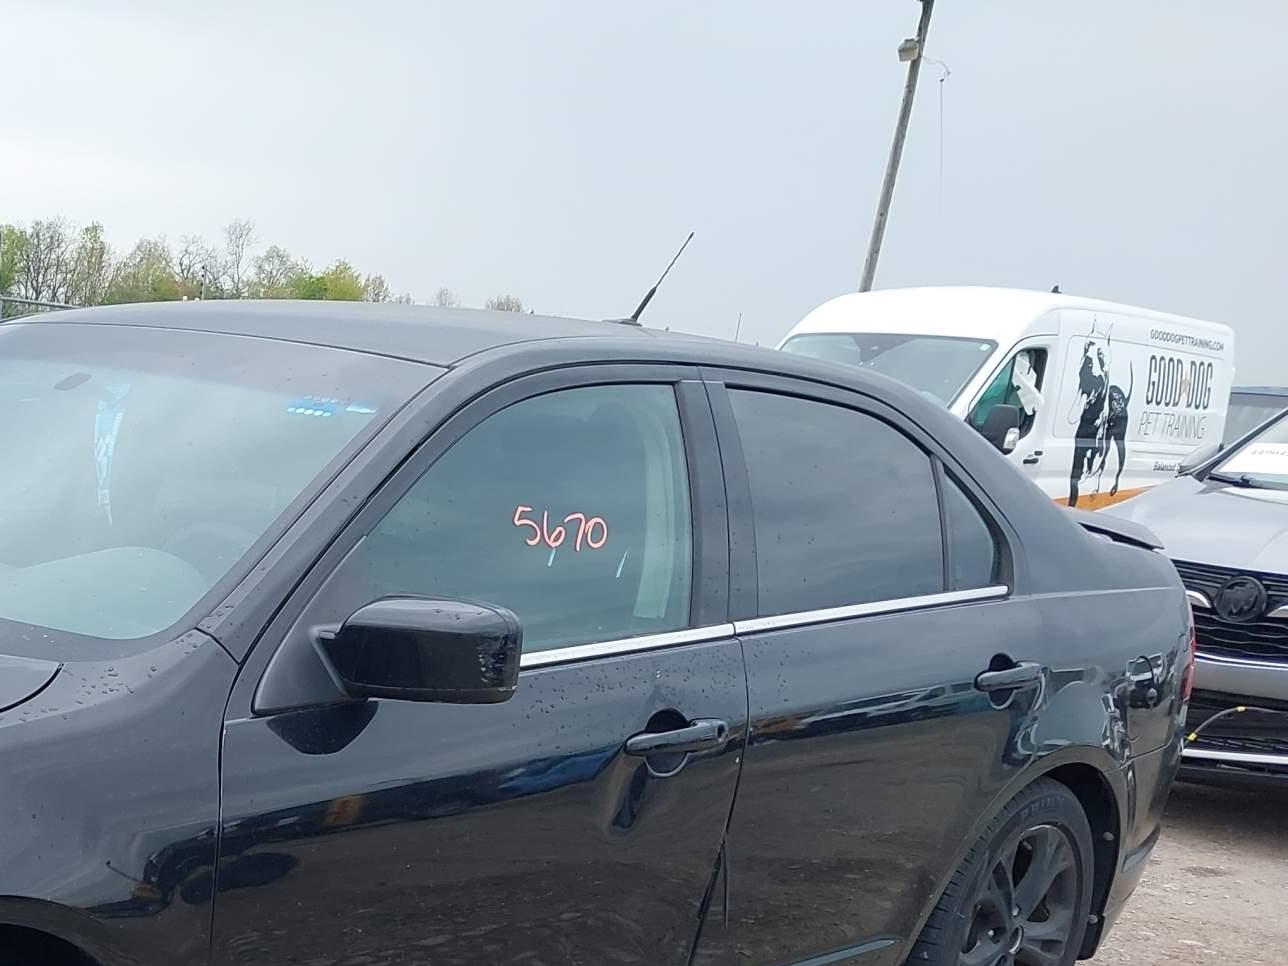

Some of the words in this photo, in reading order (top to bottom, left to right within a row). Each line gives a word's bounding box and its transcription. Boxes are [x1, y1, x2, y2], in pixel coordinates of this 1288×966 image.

[1150, 328, 1225, 352] GOODDOGPETTRAINING.COM
[1145, 354, 1184, 408] GOOD
[1185, 360, 1214, 411] DOG
[1137, 411, 1162, 436] PET
[1161, 413, 1208, 440] TRAINING
[513, 505, 608, 552] 5670
